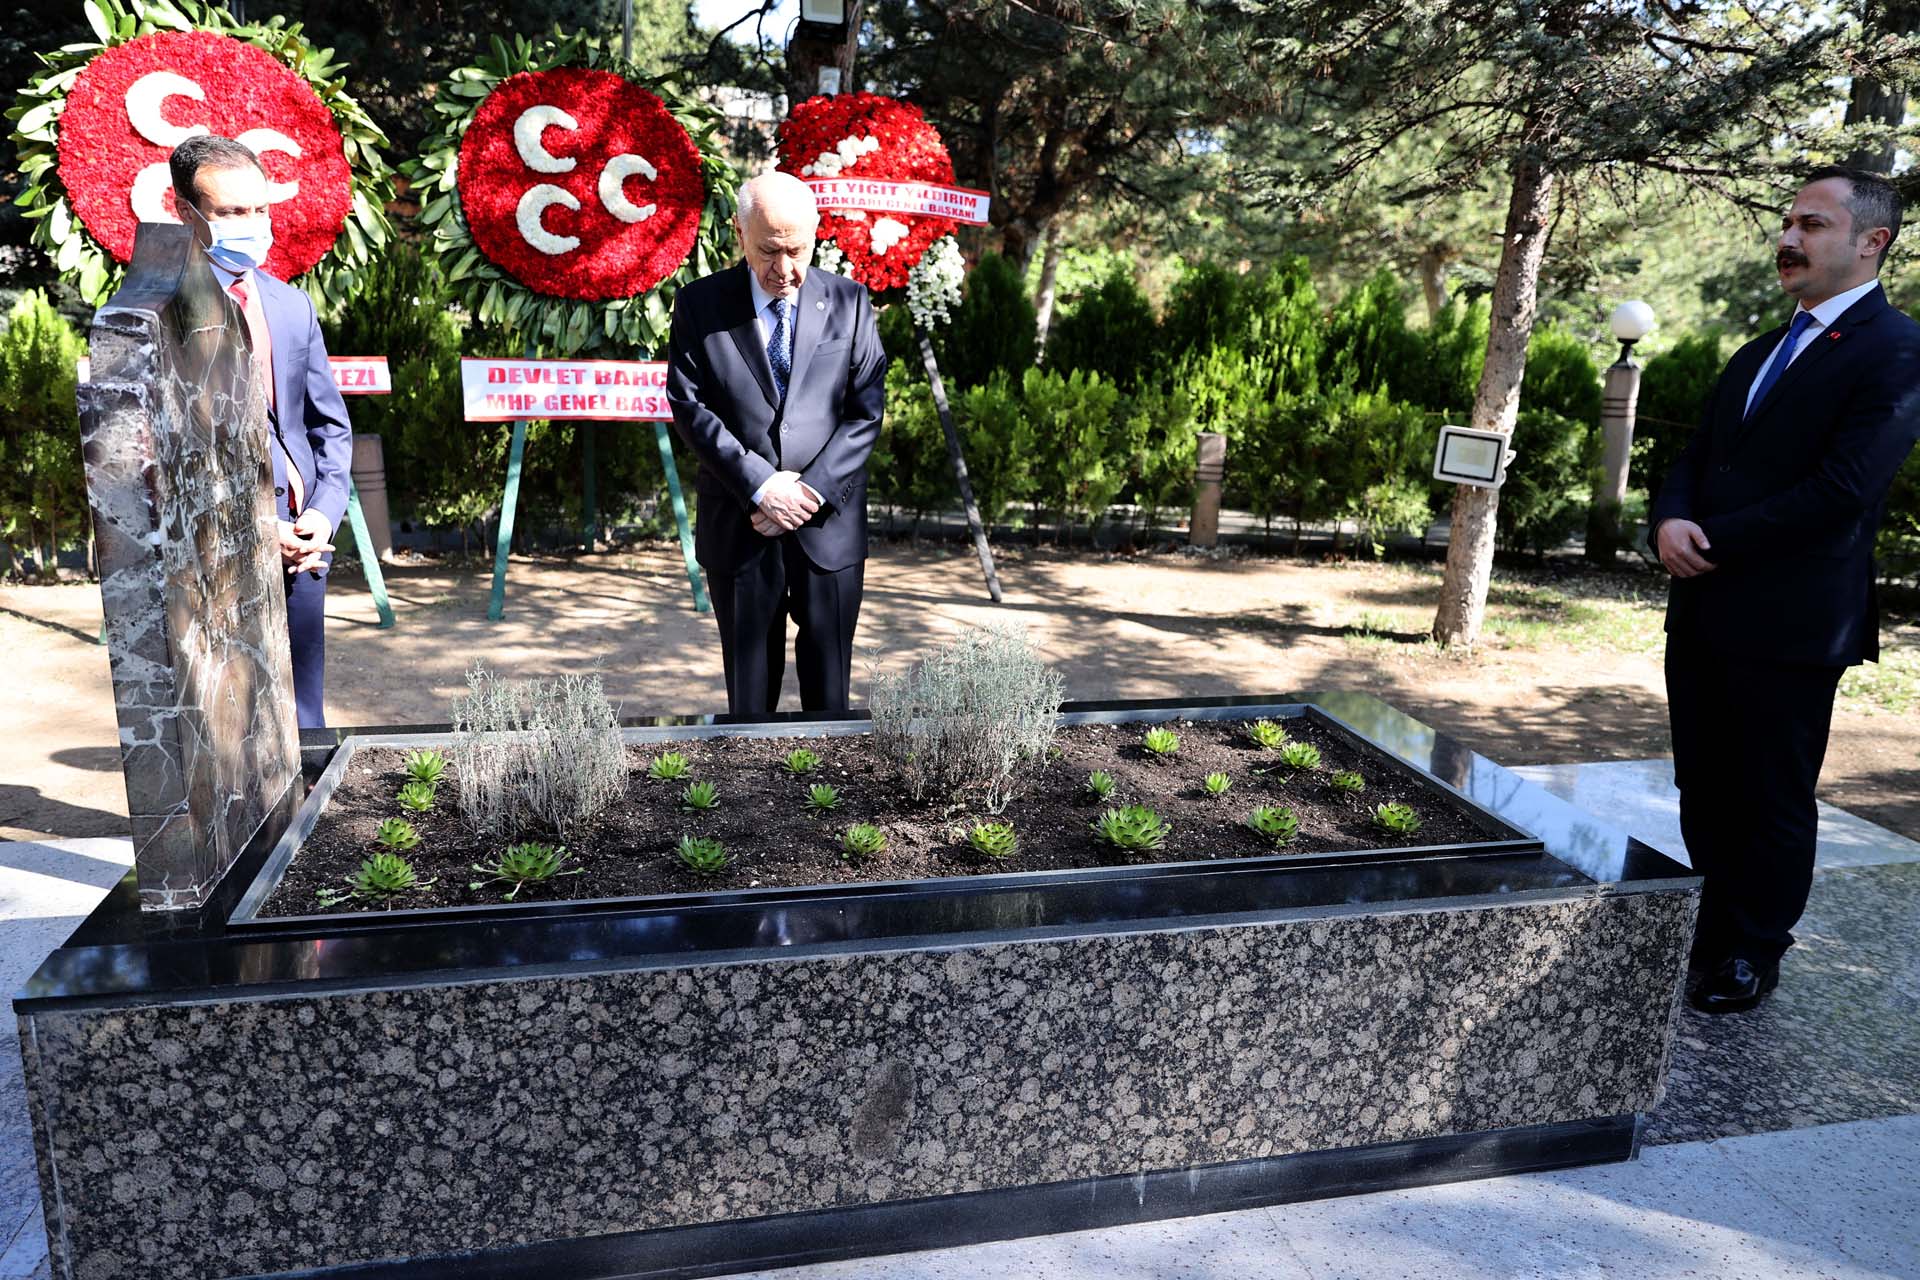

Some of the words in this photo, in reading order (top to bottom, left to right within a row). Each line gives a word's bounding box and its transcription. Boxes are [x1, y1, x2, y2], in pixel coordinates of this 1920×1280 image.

[488, 367, 586, 385] DEVLET
[486, 394, 537, 411] MHP
[544, 394, 610, 411] GENEL
